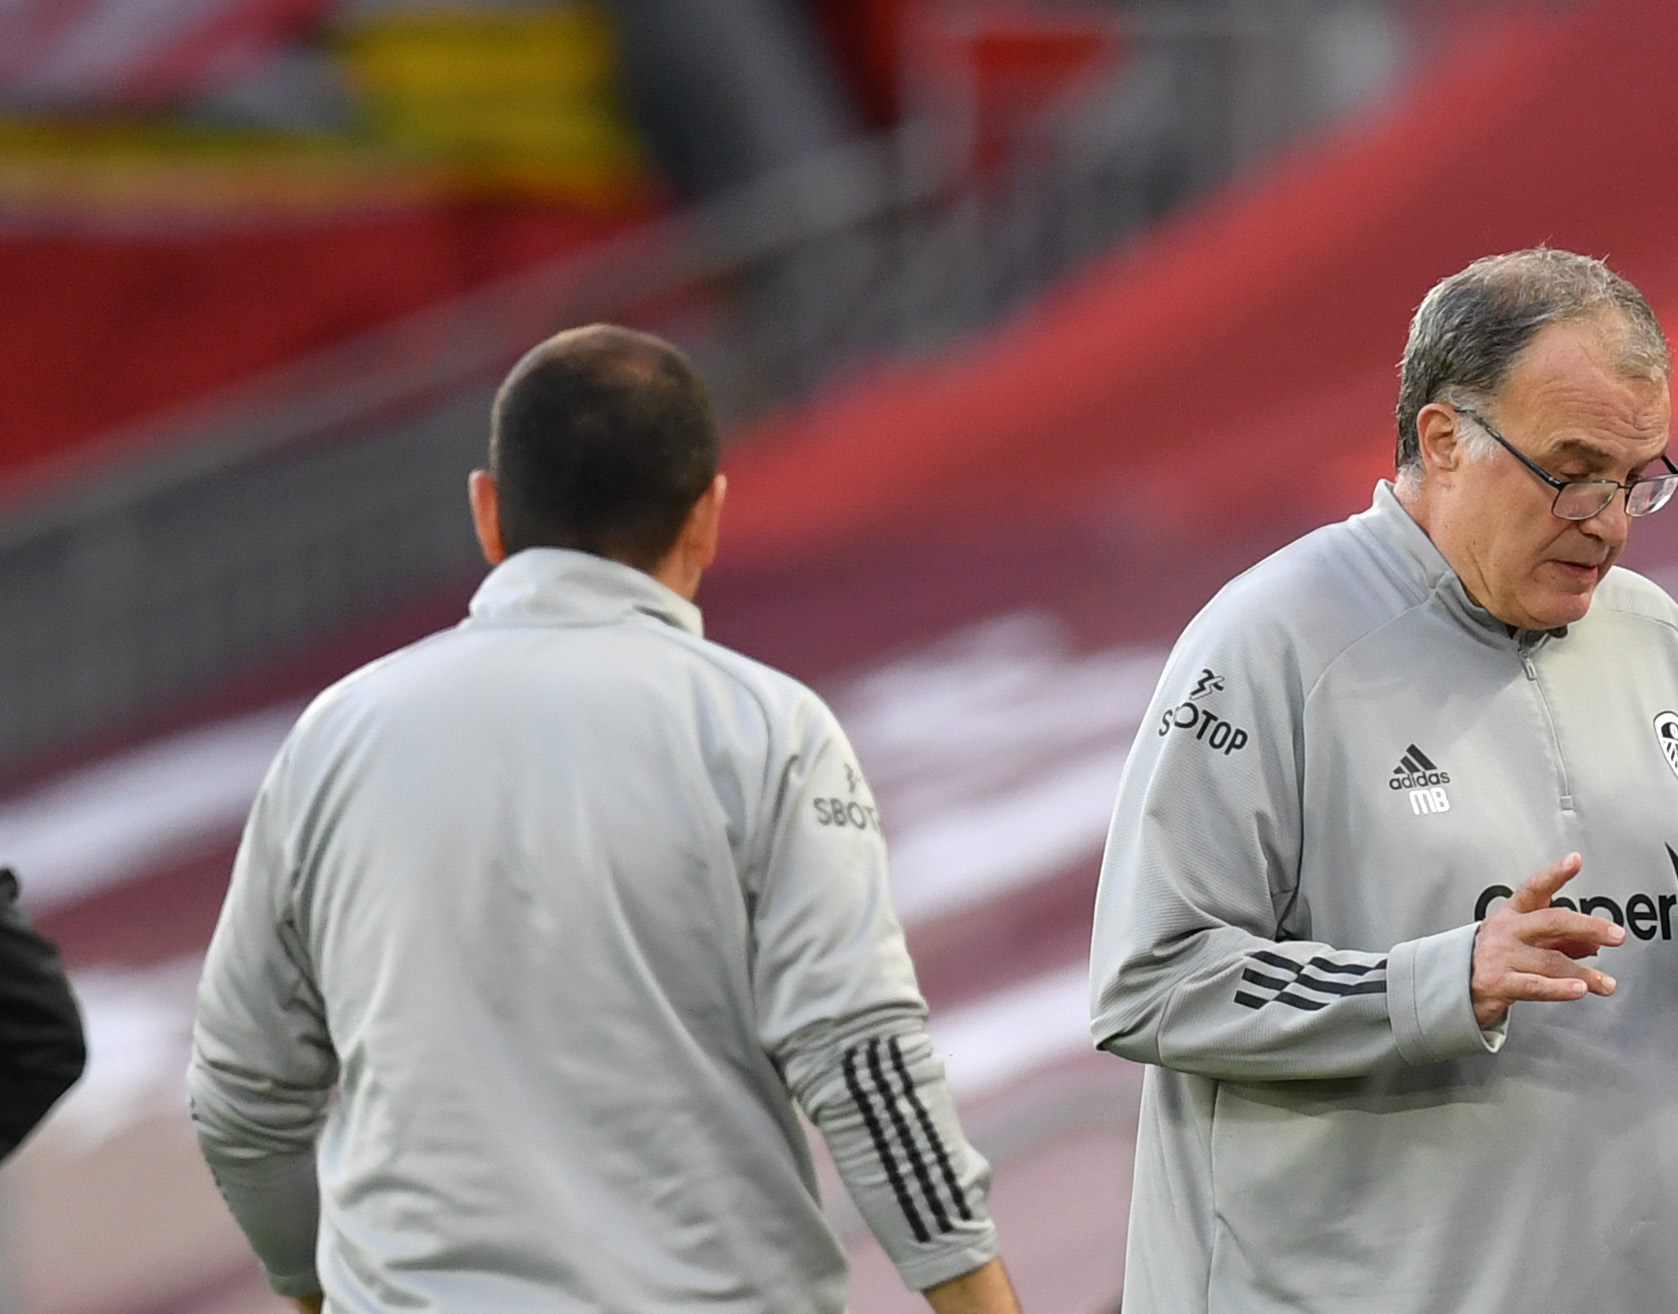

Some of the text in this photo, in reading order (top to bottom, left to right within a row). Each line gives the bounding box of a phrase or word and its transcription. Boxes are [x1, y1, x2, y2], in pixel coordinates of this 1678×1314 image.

[1158, 702, 1249, 756] SOTOP
[1389, 771, 1451, 790] adidas
[813, 797, 881, 835] SBOT
[1409, 787, 1450, 816] MB
